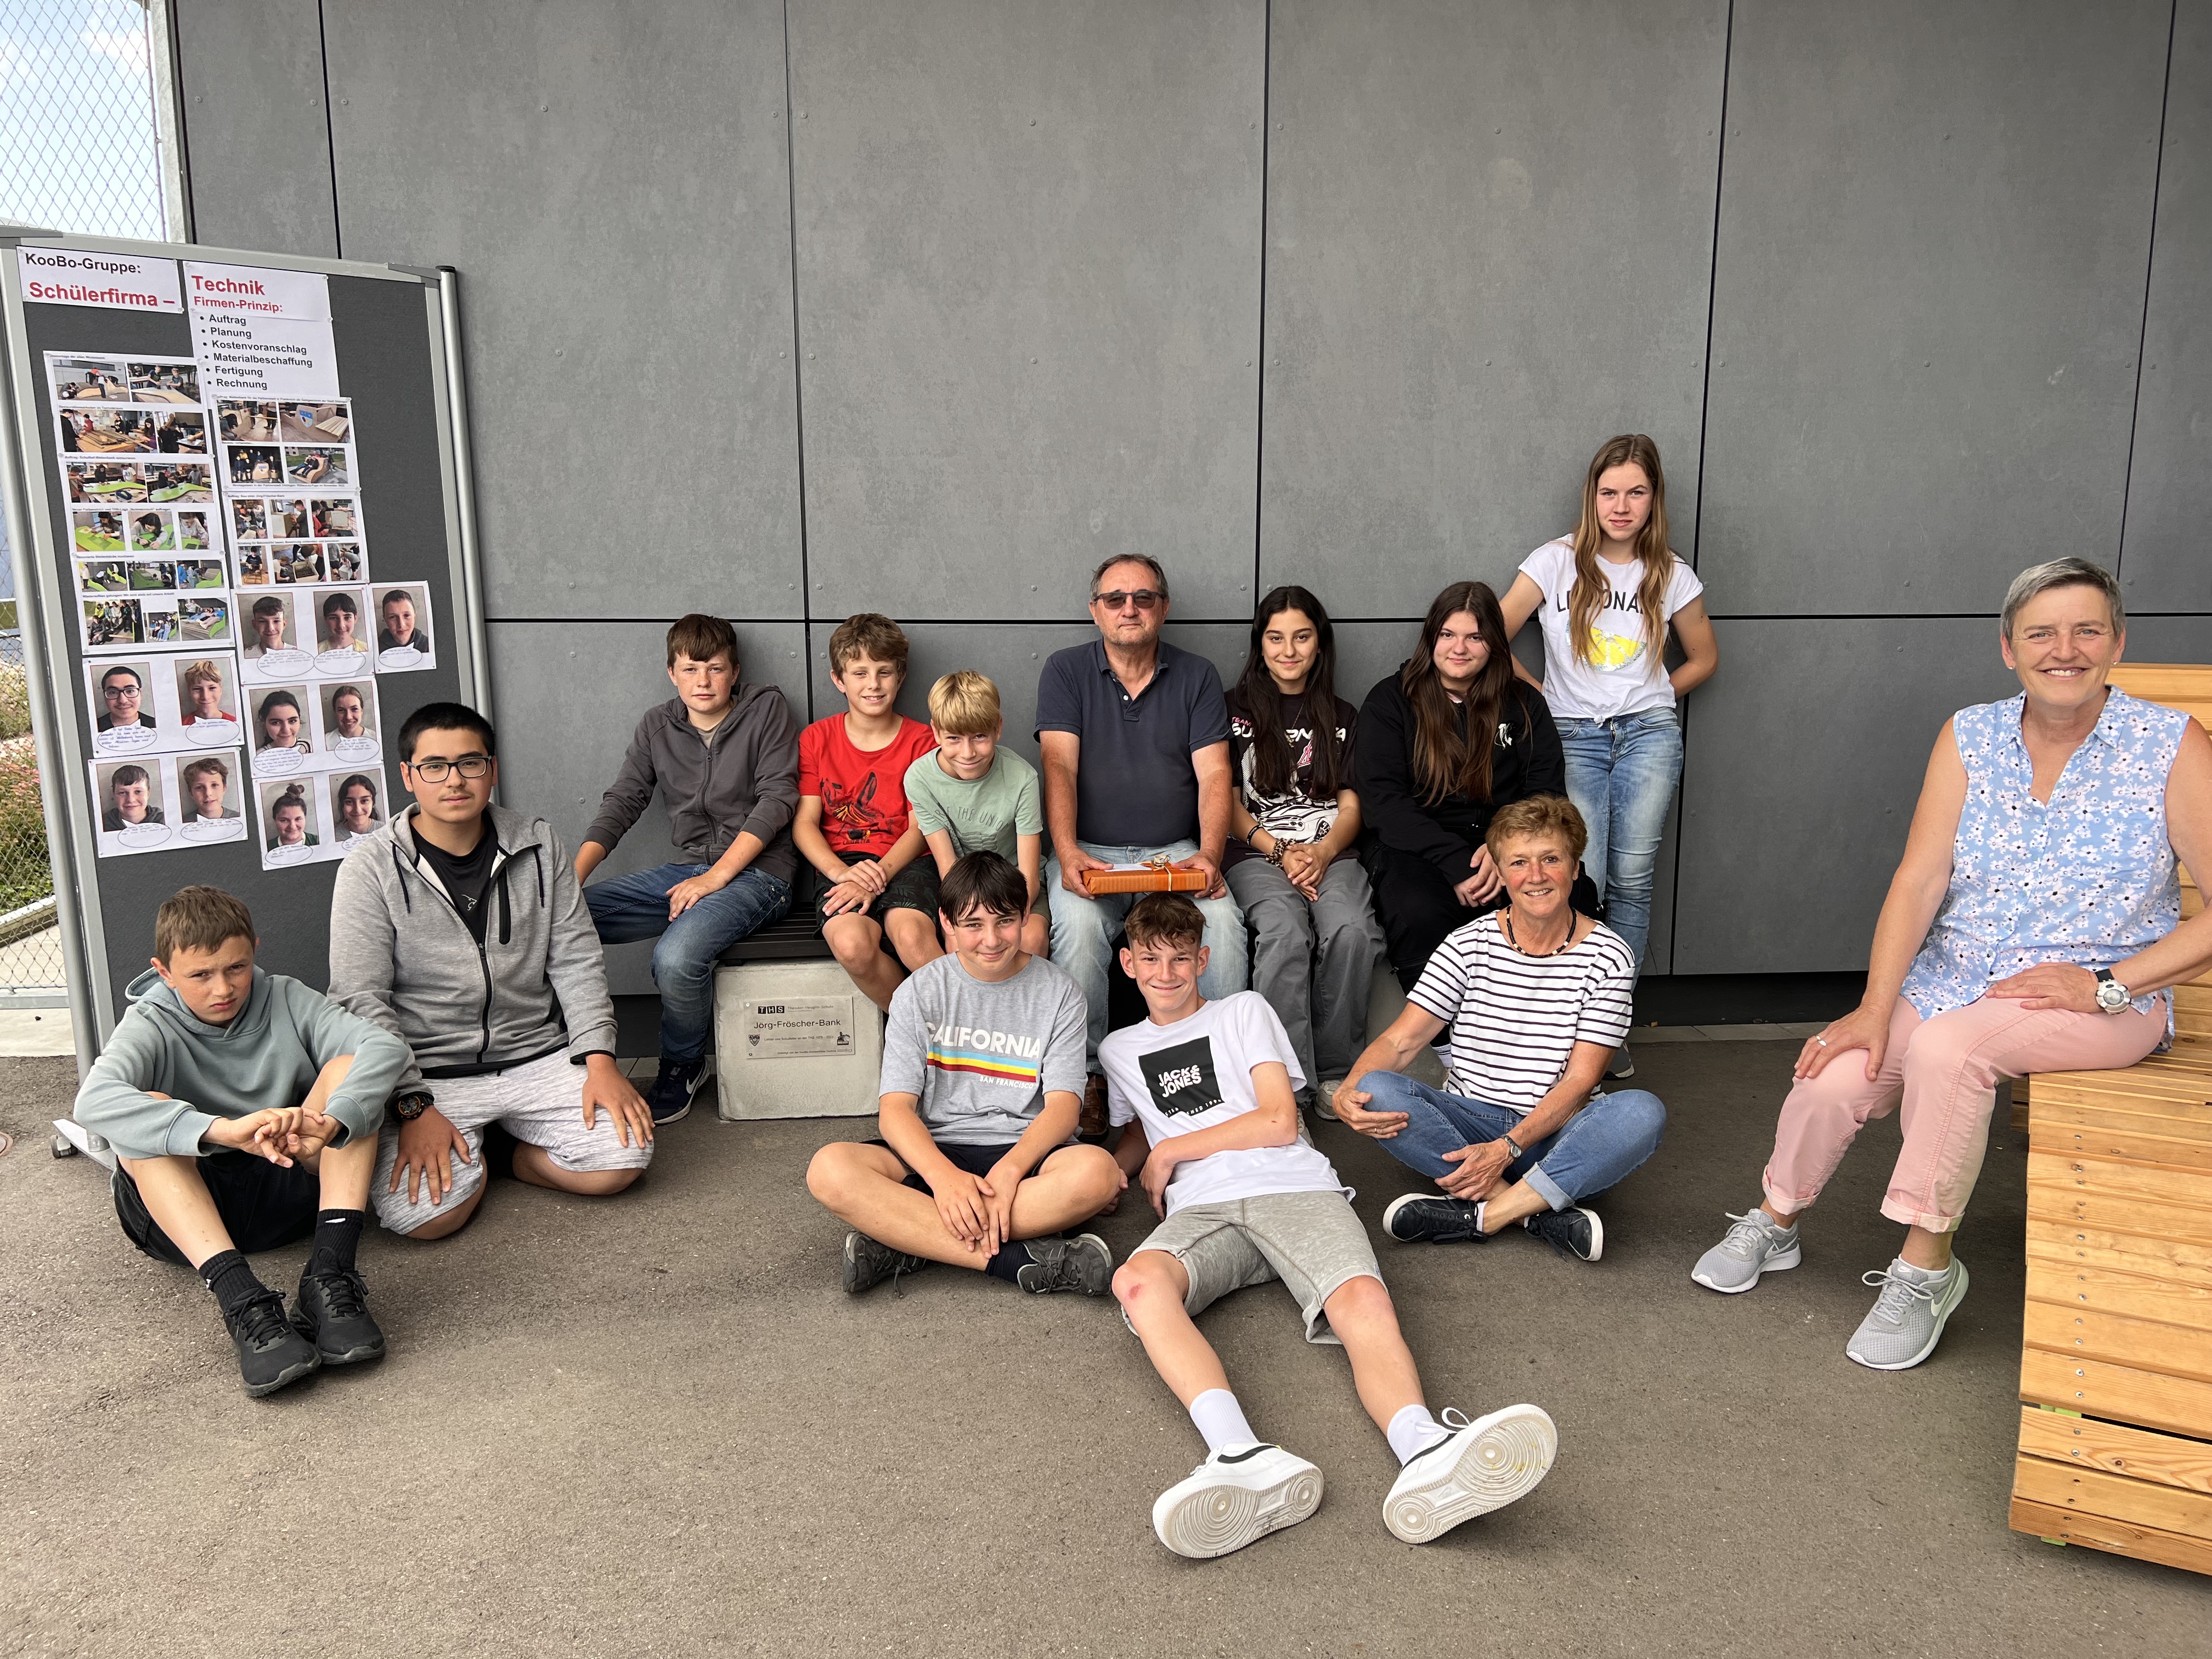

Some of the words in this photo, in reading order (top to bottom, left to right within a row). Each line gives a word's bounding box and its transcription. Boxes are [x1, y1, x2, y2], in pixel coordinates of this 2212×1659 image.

[25, 253, 141, 274] KooBo-Gruppe:
[191, 275, 266, 296] Technik
[29, 281, 159, 307] Schülerfirma
[194, 296, 283, 313] Firmen-Prinzip:
[209, 314, 246, 326] Auftrag
[210, 327, 252, 339] Planung
[212, 340, 307, 355] Kostenvoranschlag
[213, 353, 313, 368] Materialbeschaffung
[215, 365, 263, 377] Fertigung
[216, 379, 268, 390] Rechnung
[1232, 716, 1252, 727] TEAM
[958, 806, 975, 821] THE
[754, 1019, 841, 1030] Jörg-Fröscher-Bank
[926, 1022, 1041, 1058] CALIFORNIA
[979, 1075, 994, 1084] SAN
[996, 1078, 1034, 1089] FRANCISCO
[1162, 1071, 1201, 1098] JONES
